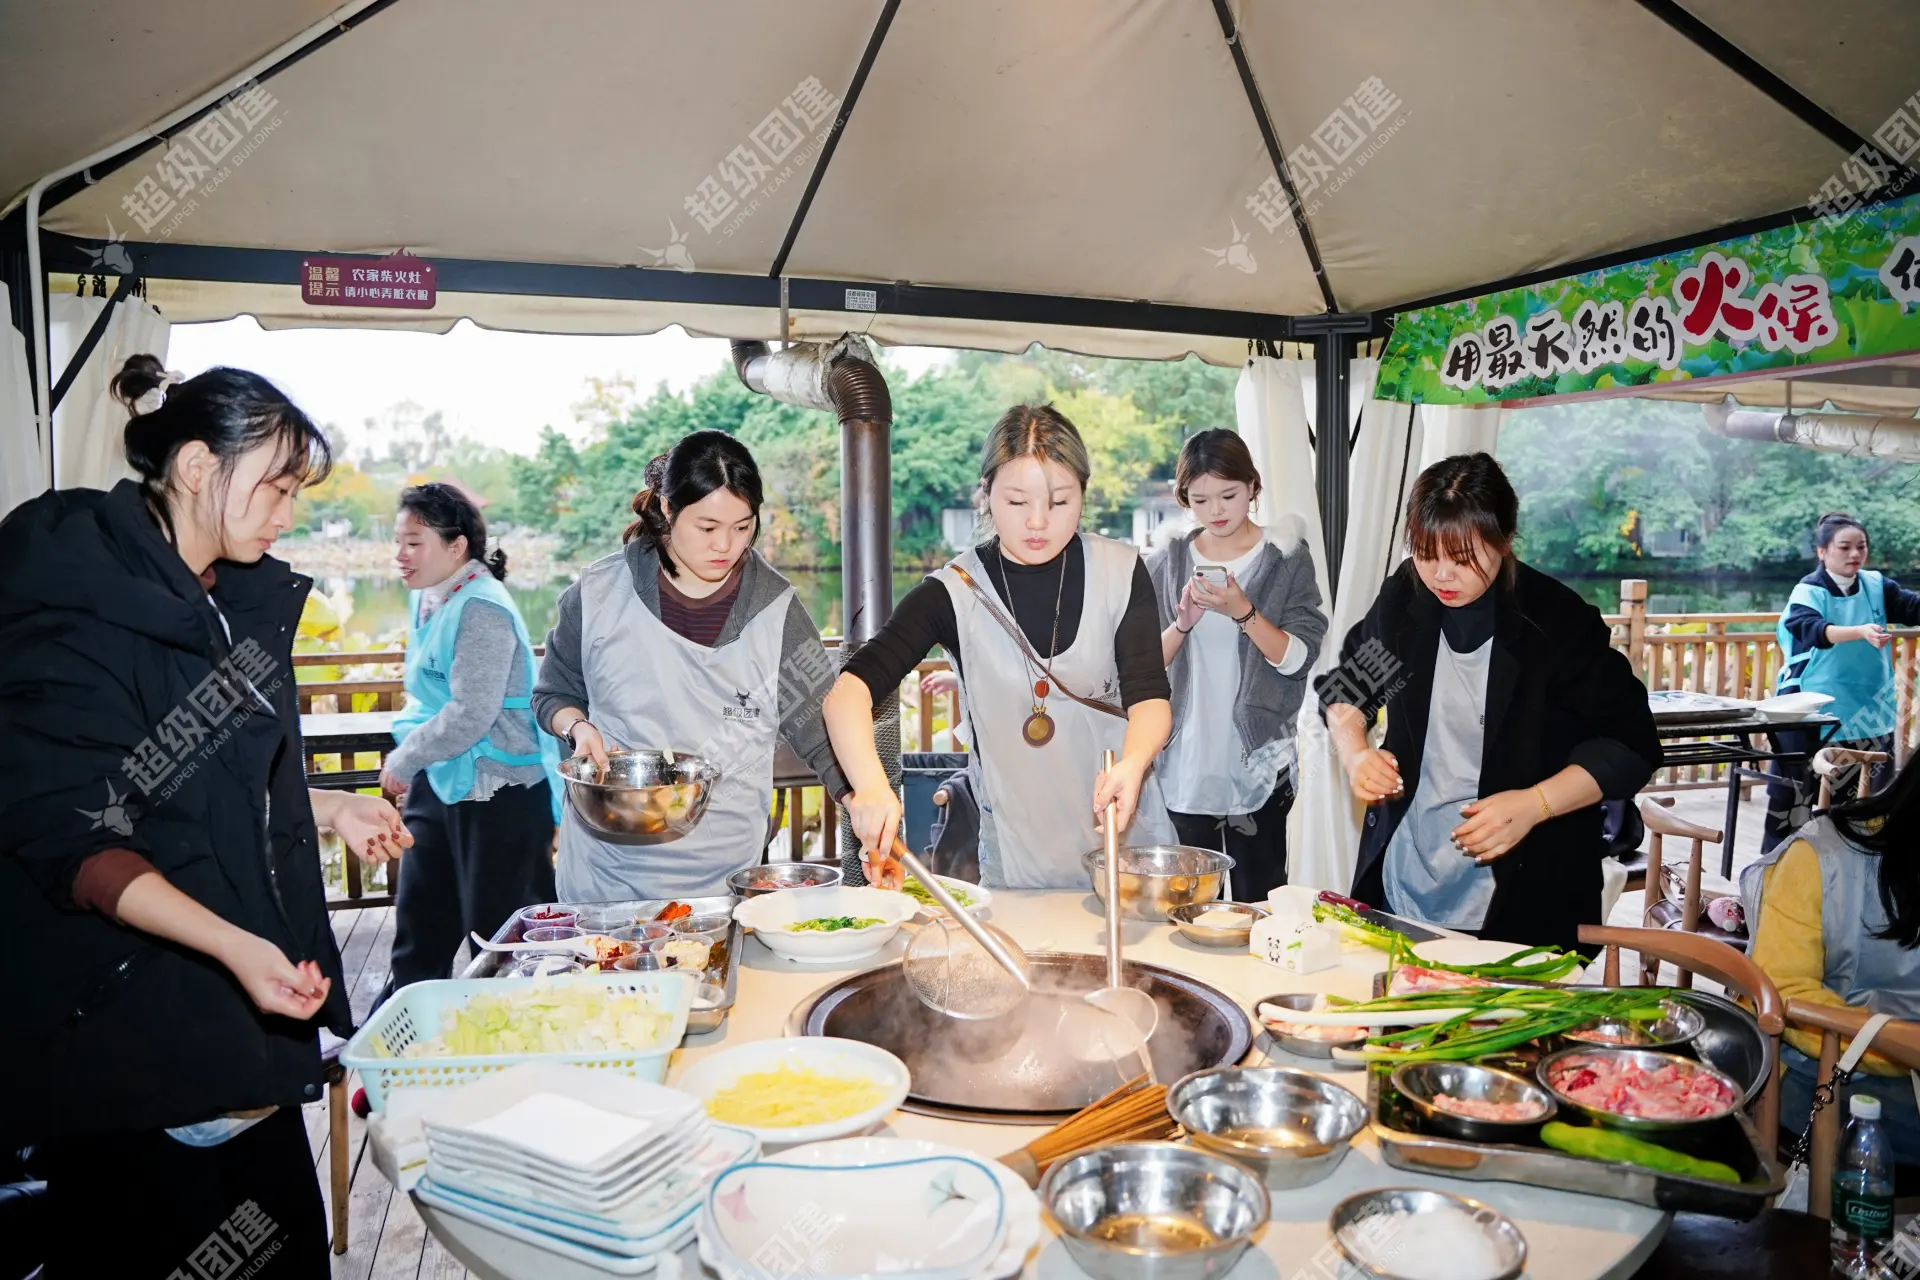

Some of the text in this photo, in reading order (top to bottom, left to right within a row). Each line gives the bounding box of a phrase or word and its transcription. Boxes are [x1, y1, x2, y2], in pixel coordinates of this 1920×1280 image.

[308, 266, 339, 281] 温馨
[351, 268, 421, 284] 农家柴火灶
[308, 281, 340, 296] 提示
[344, 286, 428, 300] 请小心弄脏衣服
[1446, 261, 1828, 382] 用最天然的火候
